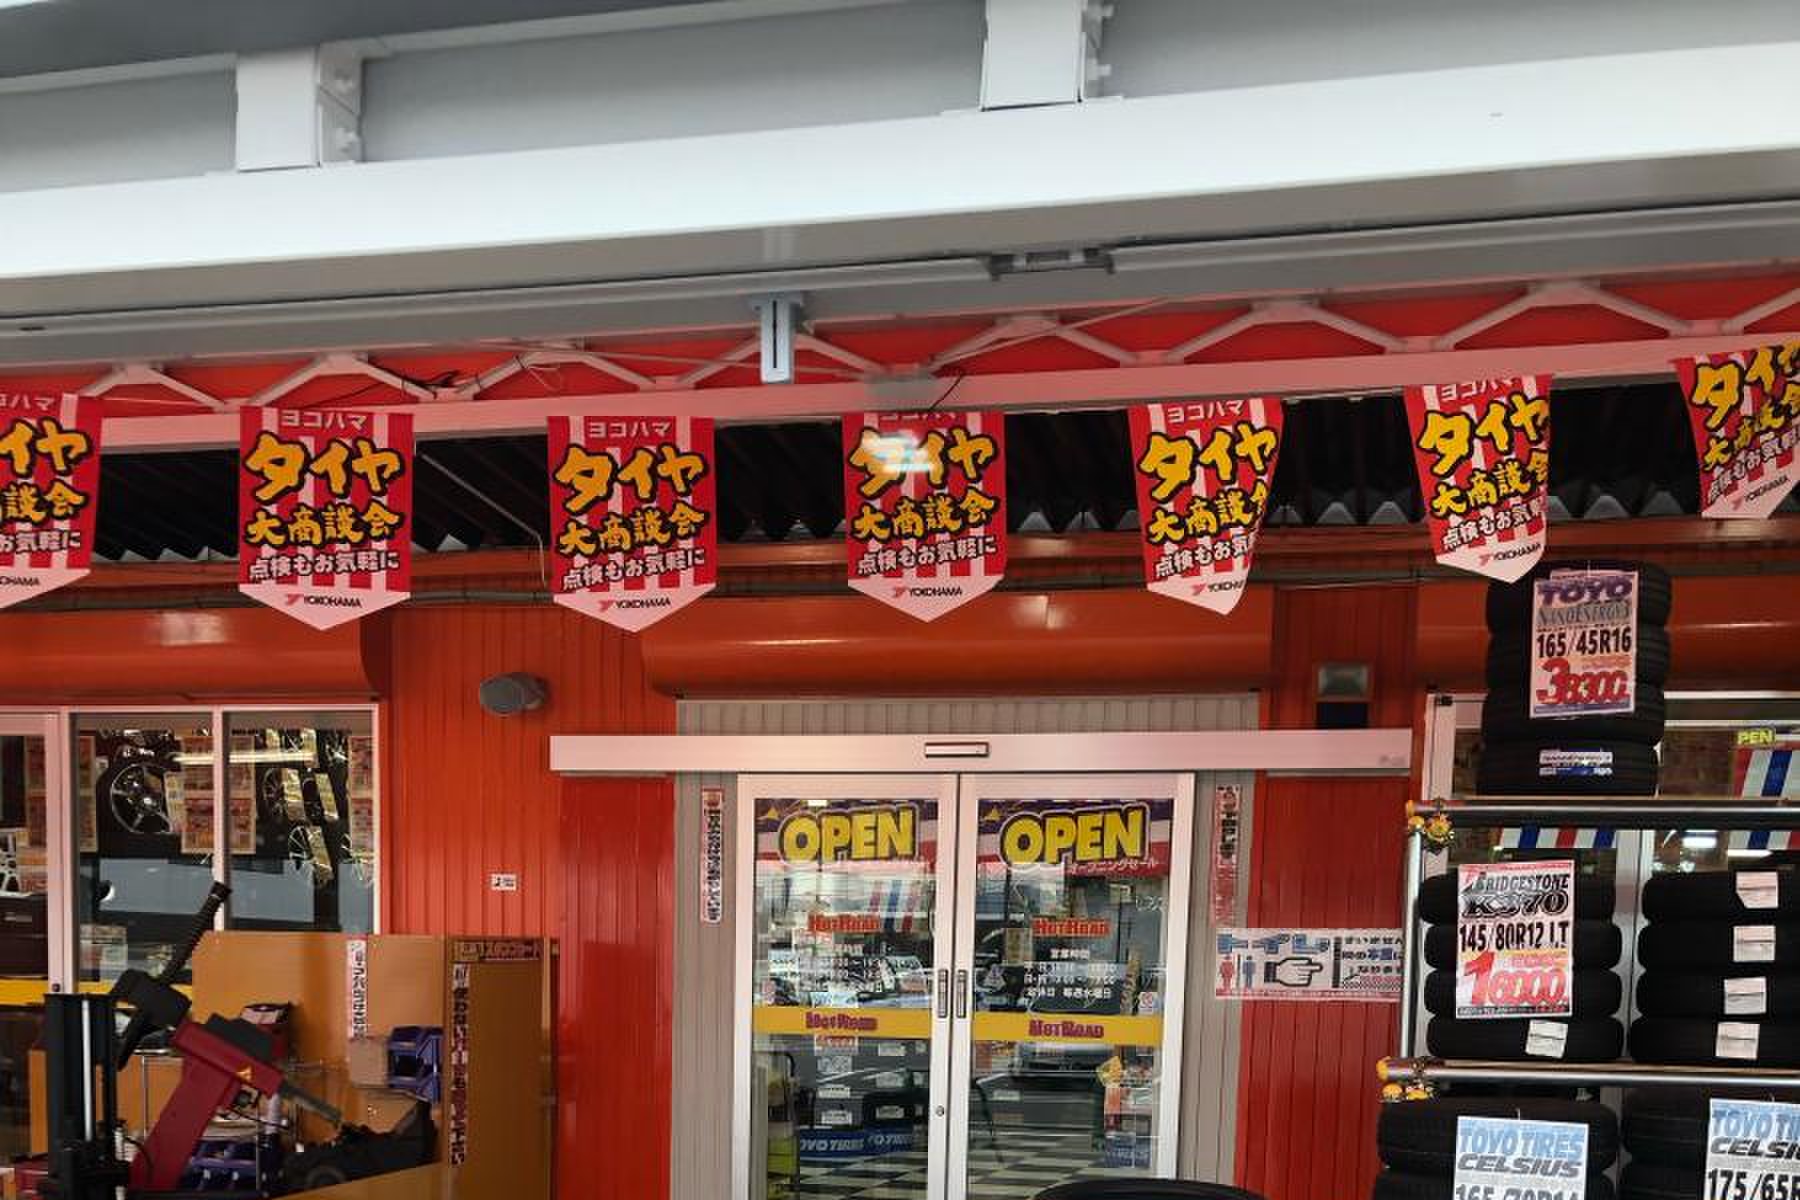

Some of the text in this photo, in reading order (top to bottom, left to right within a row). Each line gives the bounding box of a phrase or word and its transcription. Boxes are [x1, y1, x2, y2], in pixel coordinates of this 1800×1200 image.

[282, 409, 367, 430] ヨコハマ
[1168, 400, 1244, 423] ヨコハマ
[588, 421, 671, 438] ヨコハマ
[1418, 393, 1550, 475] タイヤ
[243, 430, 404, 502] タイヤ
[849, 427, 997, 499] タイヤ
[1138, 421, 1279, 500] タイヤ
[553, 444, 707, 514] タイヤ
[245, 501, 403, 547] 大商談会
[558, 500, 706, 556] 大商談会
[852, 487, 998, 541] 大商談会
[248, 550, 400, 582] 点検もお気軽に
[562, 549, 704, 592] 点検もお気軽に
[858, 537, 997, 576] 点検もお気軽に
[303, 596, 363, 609] YOKOHAMA
[616, 597, 671, 610] YOKOHAMA
[909, 586, 962, 598] YOKOHAMA
[1537, 576, 1632, 605] TOYO
[1536, 626, 1632, 658] 165/45R16
[781, 806, 917, 863] OPEN
[1003, 807, 1145, 865] OPEN
[1470, 873, 1570, 893] BRIDGESTONE
[1713, 1109, 1772, 1139] TOYO
[1458, 1127, 1584, 1158] TOYO TIRES
[1711, 1137, 1800, 1160] CELSI
[1458, 1153, 1582, 1178] CELSIUS
